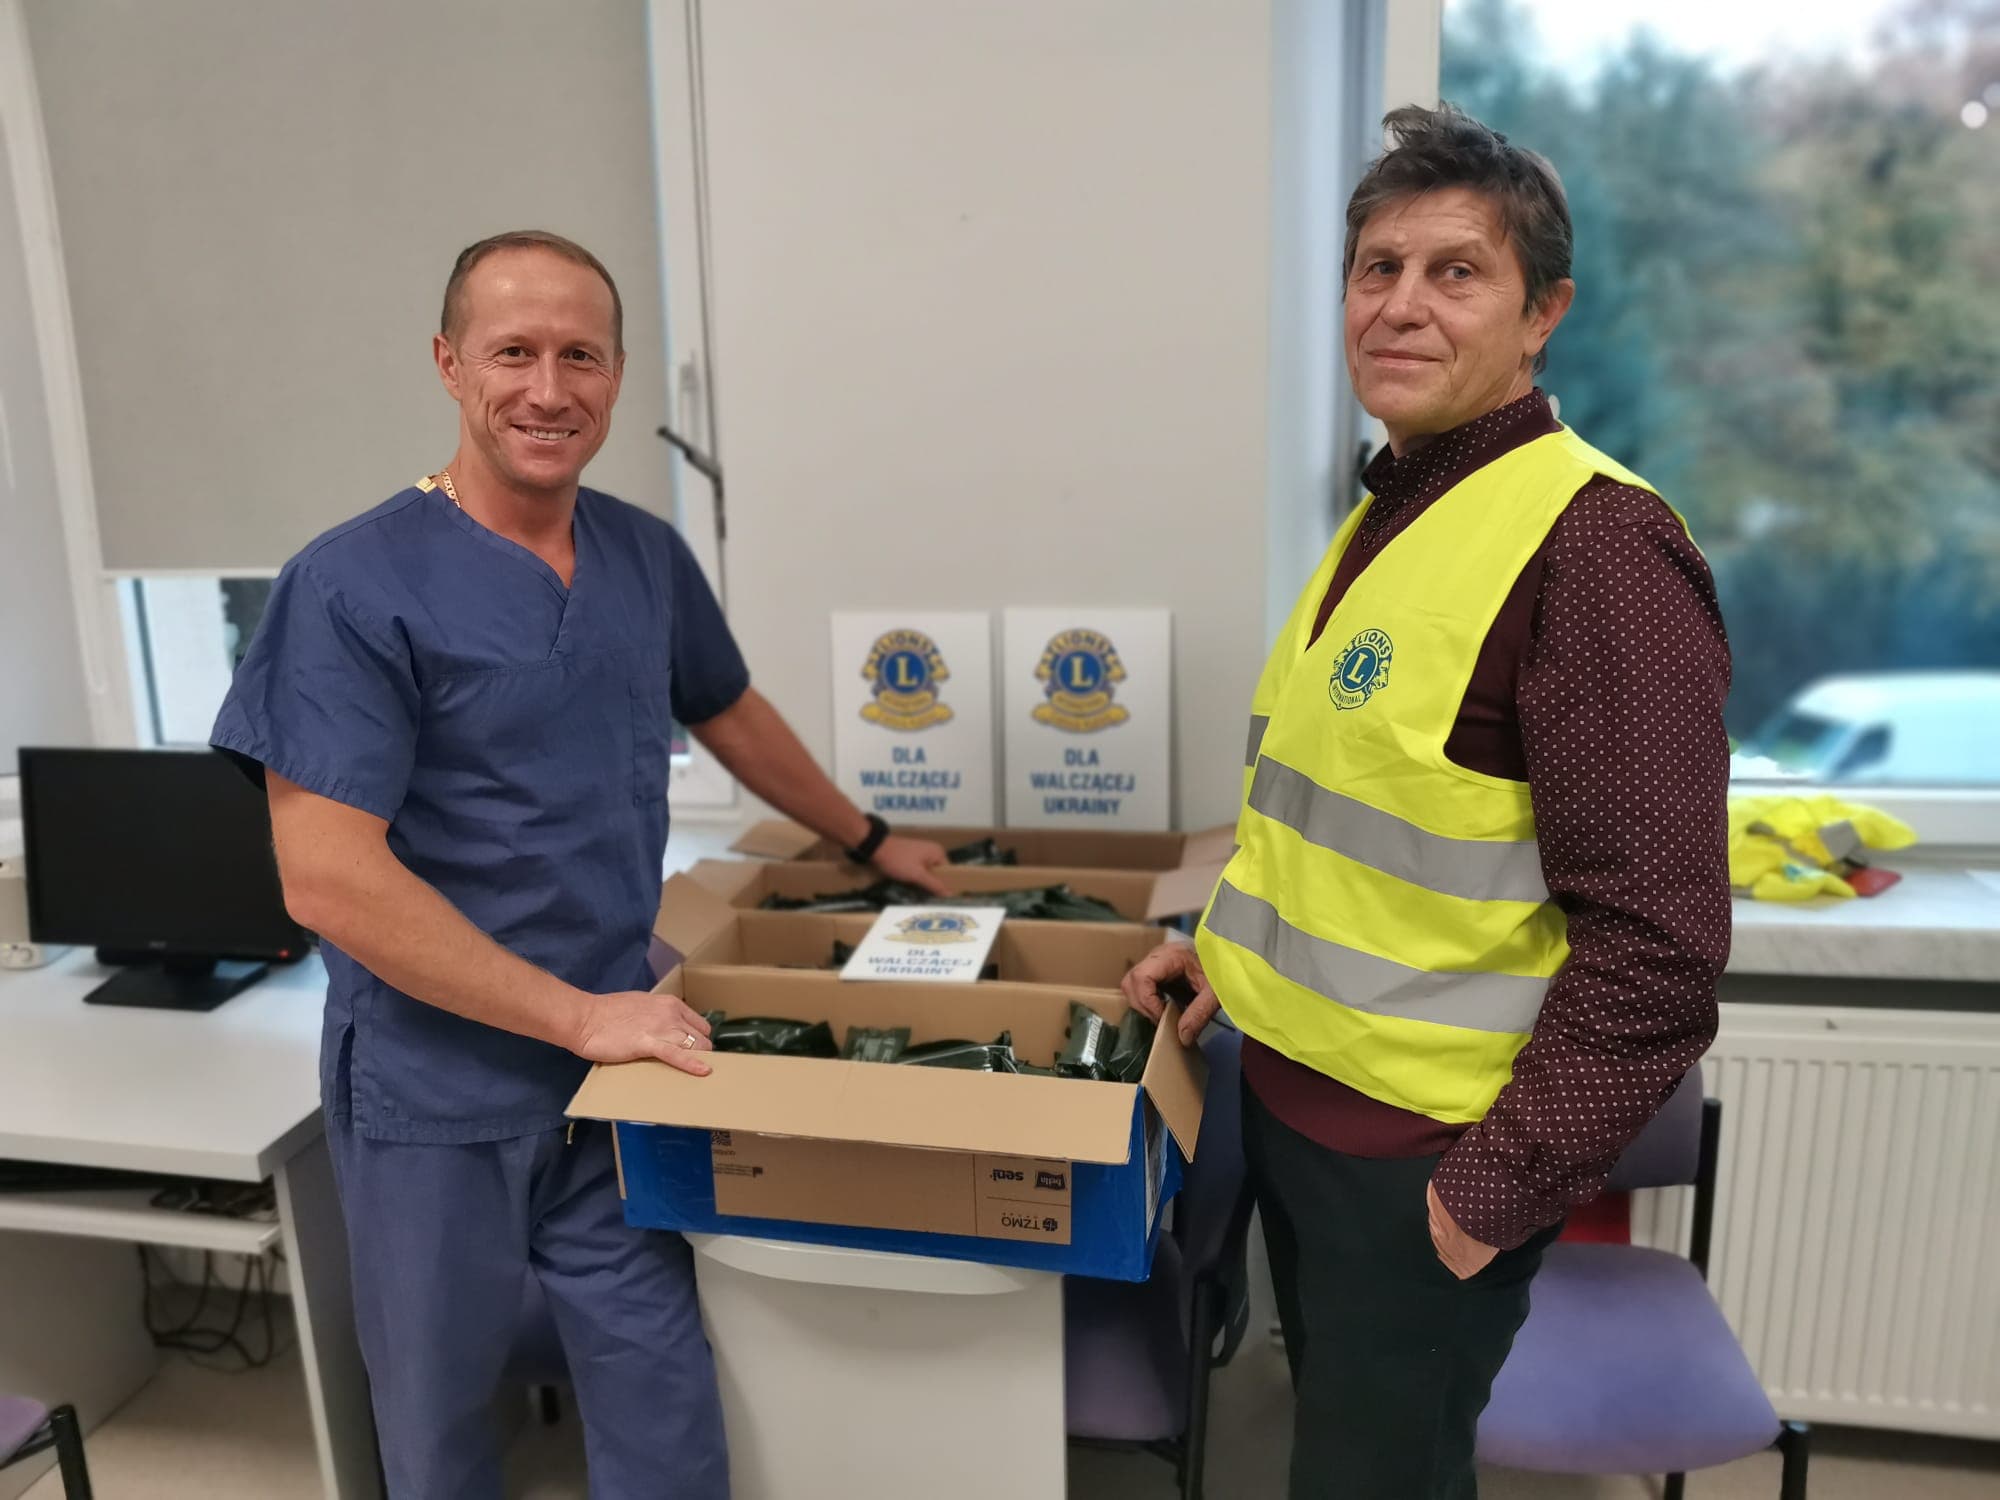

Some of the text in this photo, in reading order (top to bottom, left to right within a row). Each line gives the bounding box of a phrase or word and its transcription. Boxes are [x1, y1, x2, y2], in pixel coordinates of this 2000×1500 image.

[1358, 632, 1389, 655] LIONS
[896, 656, 917, 686] L
[1071, 656, 1093, 687] L
[1347, 653, 1368, 683] L
[892, 747, 925, 764] DLA
[1064, 749, 1099, 766] DLA
[860, 770, 960, 790] WALCZĄCEJ
[1030, 773, 1134, 793] WALCZĄCEJ
[873, 796, 946, 812] UKRAINY
[1044, 797, 1120, 815] UKRAINY
[907, 949, 941, 957] DLA
[876, 966, 954, 975] UKRAINY
[992, 1168, 1024, 1181] seni
[1001, 1216, 1040, 1230] TZMO
